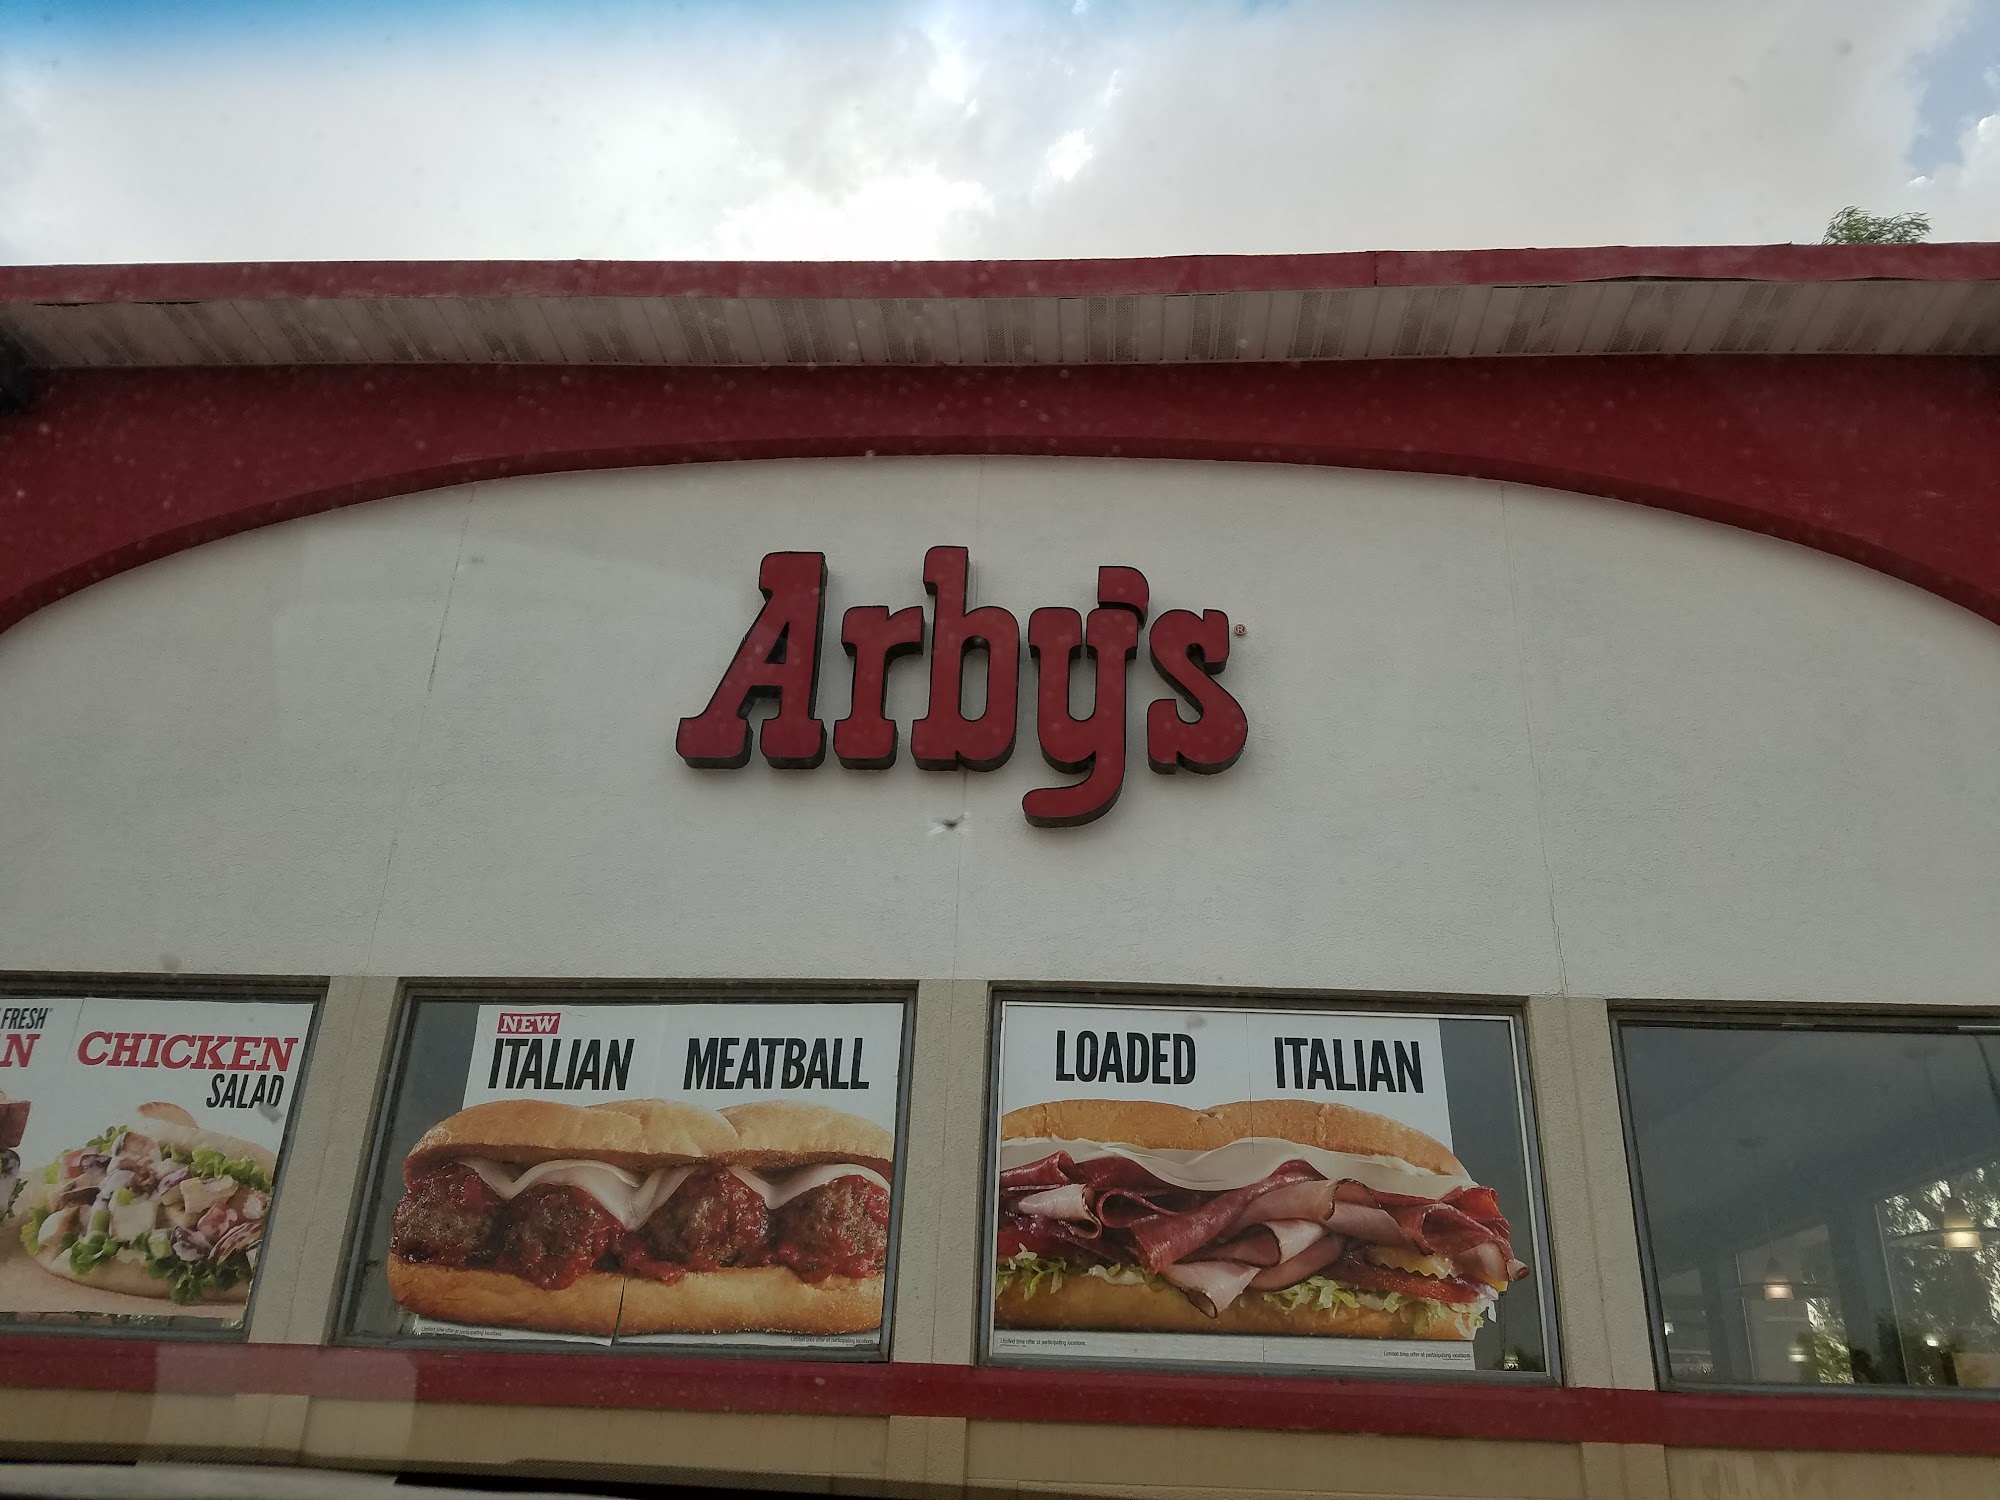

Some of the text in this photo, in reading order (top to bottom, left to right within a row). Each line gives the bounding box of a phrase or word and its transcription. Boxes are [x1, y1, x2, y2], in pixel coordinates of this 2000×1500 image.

[676, 545, 1248, 828] Arby's
[0, 1007, 48, 1030] FRESH
[500, 1015, 560, 1033] NEW
[0, 1033, 41, 1067] N
[77, 1031, 299, 1072] CHICKEN
[488, 1037, 870, 1091] ITALIAN MEATBALL
[1055, 1029, 1424, 1094] LOADED ITALIAN
[206, 1073, 285, 1109] SALAD
